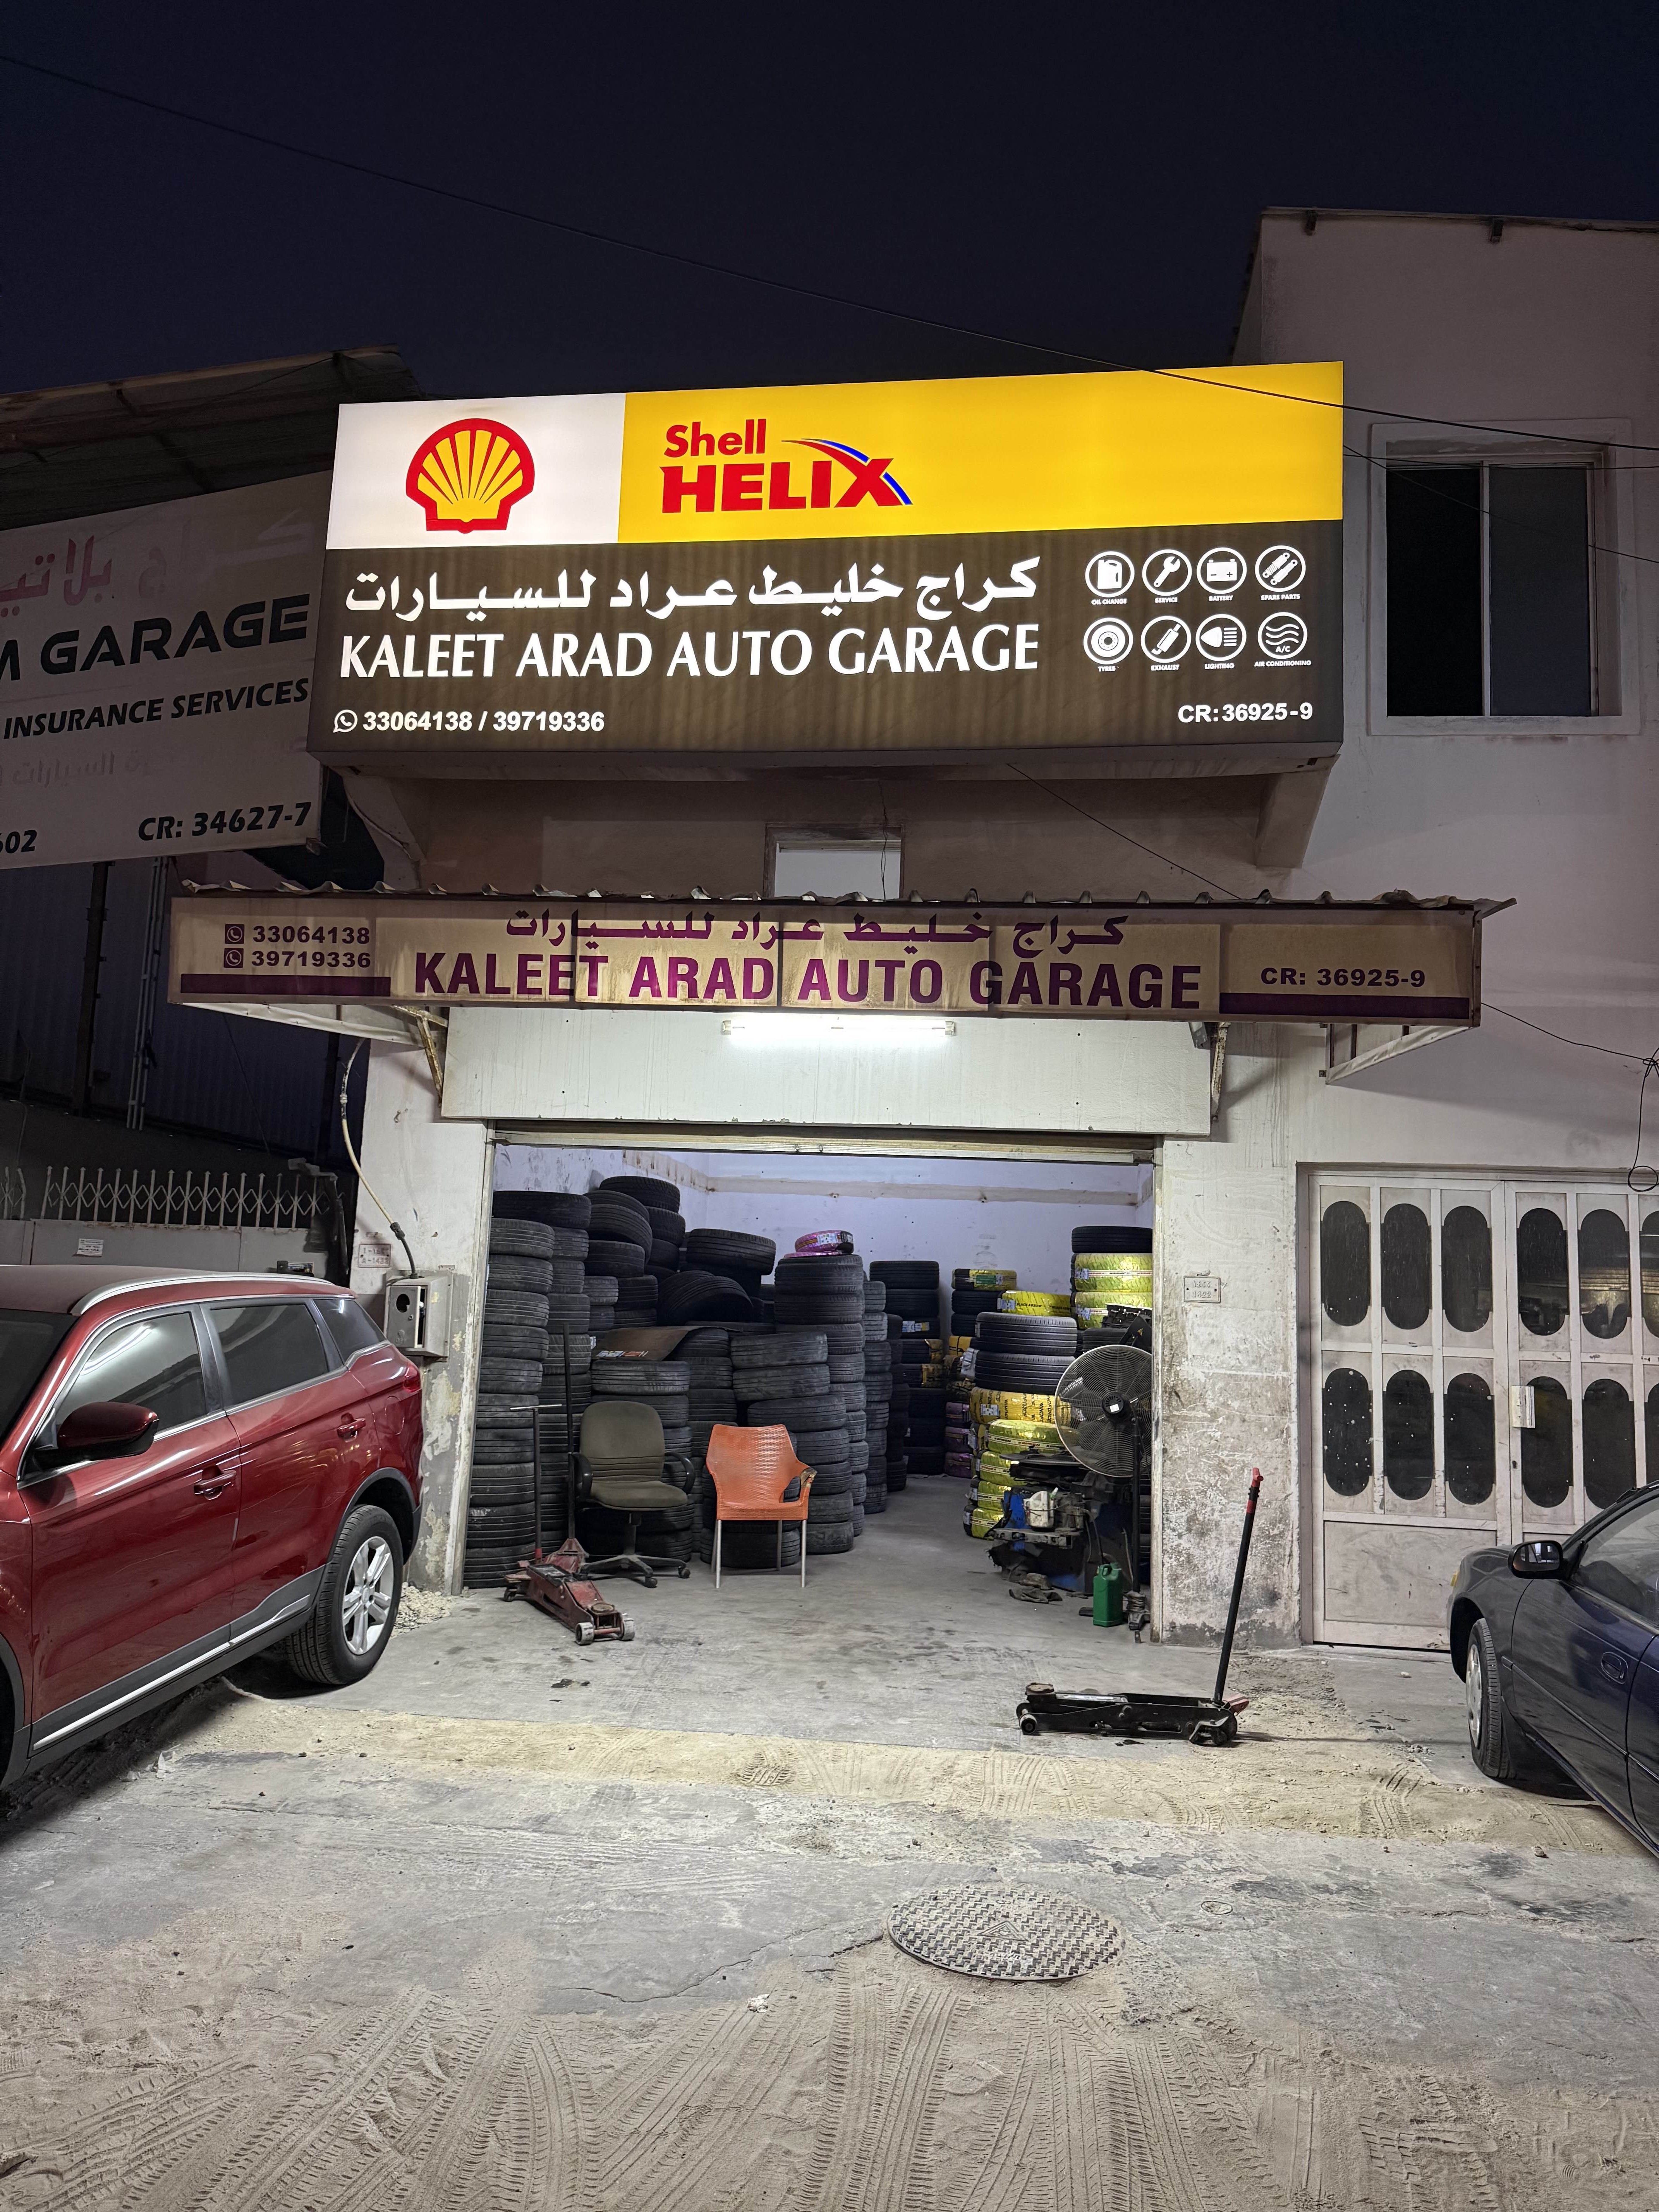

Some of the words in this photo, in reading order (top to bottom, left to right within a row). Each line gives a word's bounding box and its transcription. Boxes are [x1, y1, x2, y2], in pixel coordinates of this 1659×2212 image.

[665, 419, 766, 458] Shell
[662, 457, 895, 513] HELIX
[347, 570, 596, 622] للسيارات
[610, 572, 737, 619] عراد
[749, 563, 904, 617] خليط
[917, 557, 1040, 620] كراج
[41, 594, 310, 675] GARAGE
[341, 635, 504, 678] KALEET
[516, 634, 652, 677] ARAD
[667, 630, 812, 677] AUTO
[829, 625, 1039, 675] GARAGE
[4, 699, 164, 739] INSURANCE
[172, 678, 309, 719] SERVICES
[364, 712, 472, 731] 33064138
[479, 712, 488, 731] /
[494, 712, 605, 732] 39719336
[139, 817, 183, 841] CR:
[192, 802, 312, 836] 34627-7
[254, 926, 369, 944] 33064138
[507, 908, 714, 950] للسيارات
[731, 912, 824, 950] عراد
[843, 911, 993, 955] خليط
[1013, 915, 1129, 959] كراج
[252, 951, 371, 968] 39719336
[415, 952, 608, 997] KALEET
[629, 957, 774, 1000] ARAD
[798, 959, 943, 1004] AUTO
[970, 960, 1201, 1009] GARAGE
[1262, 968, 1305, 985] CR:
[1318, 969, 1425, 987] 36925-9
